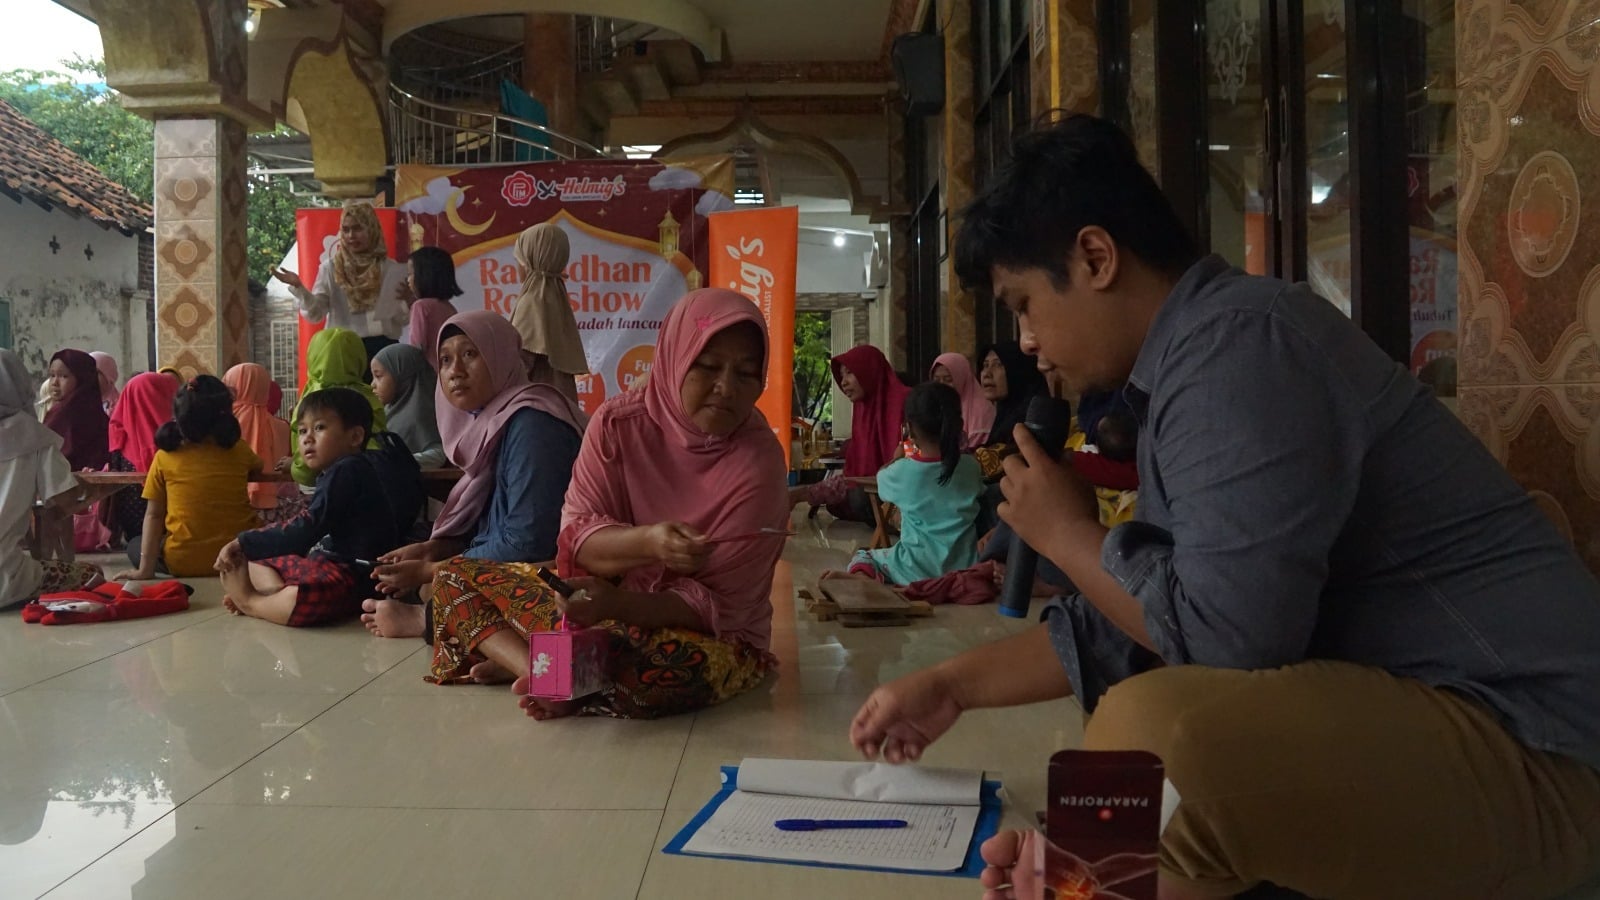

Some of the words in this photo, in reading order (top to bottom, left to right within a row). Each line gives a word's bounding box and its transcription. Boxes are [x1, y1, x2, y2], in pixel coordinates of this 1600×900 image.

[556, 175, 627, 201] Helmig's
[479, 254, 651, 286] Radhan
[484, 285, 647, 315] Roshow
[577, 317, 613, 330] adah
[635, 360, 652, 372] Fu
[1060, 796, 1149, 807] PARAPROFEN
